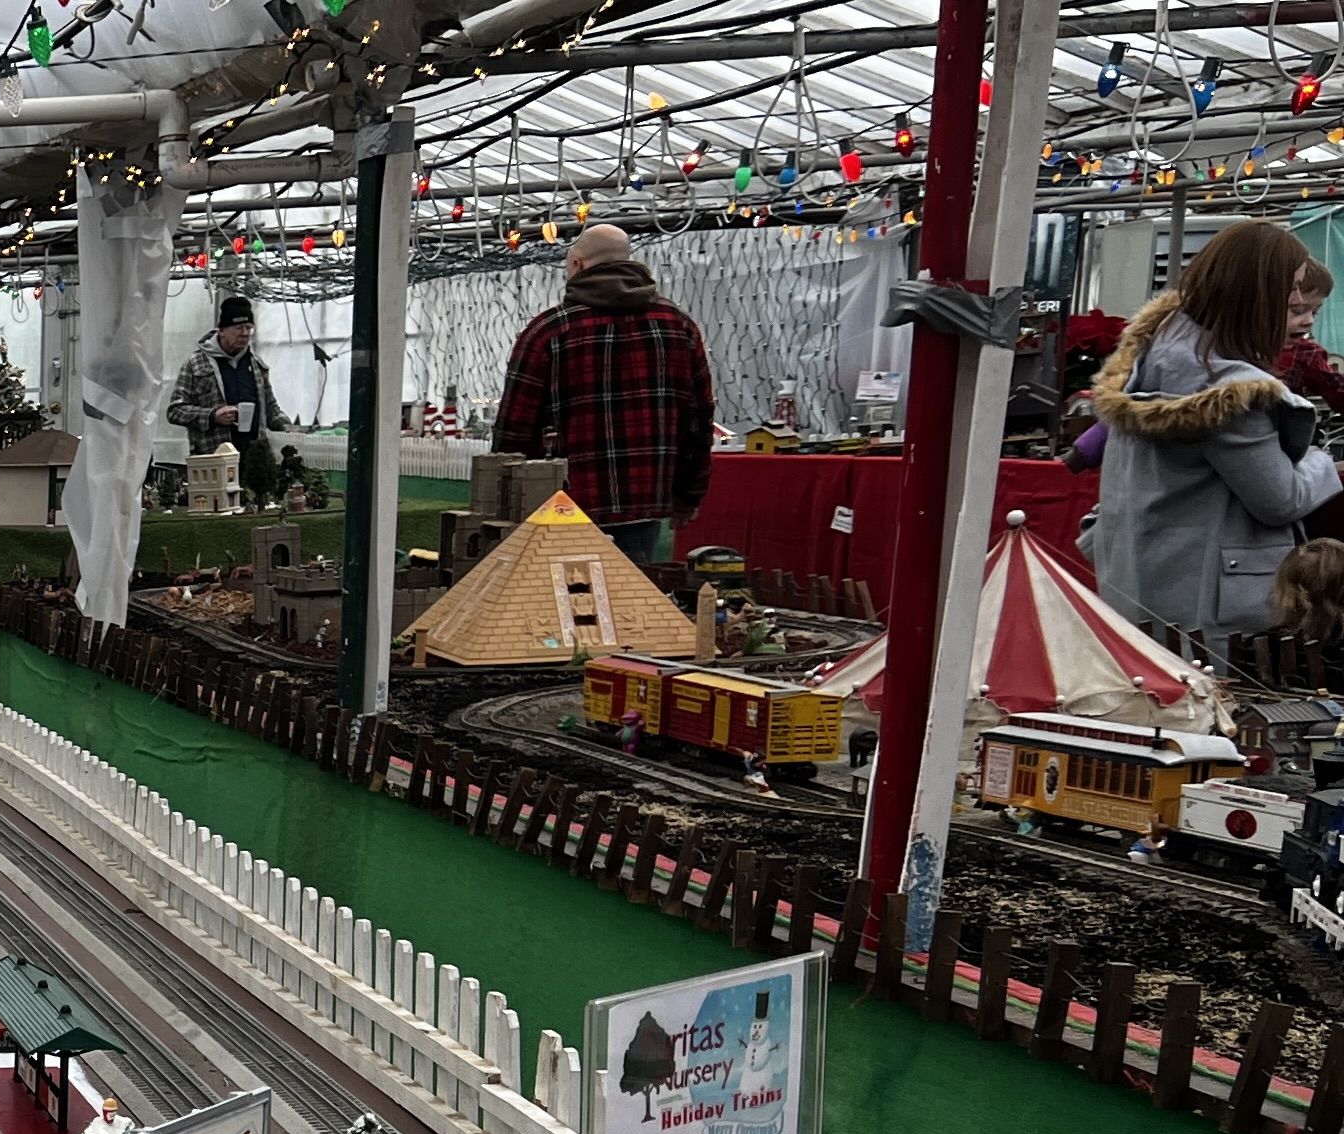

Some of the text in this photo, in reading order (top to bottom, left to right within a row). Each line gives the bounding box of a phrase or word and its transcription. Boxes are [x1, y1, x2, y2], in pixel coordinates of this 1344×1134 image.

[669, 1021, 725, 1056] ritas
[661, 1087, 783, 1130] Holiday Trains
